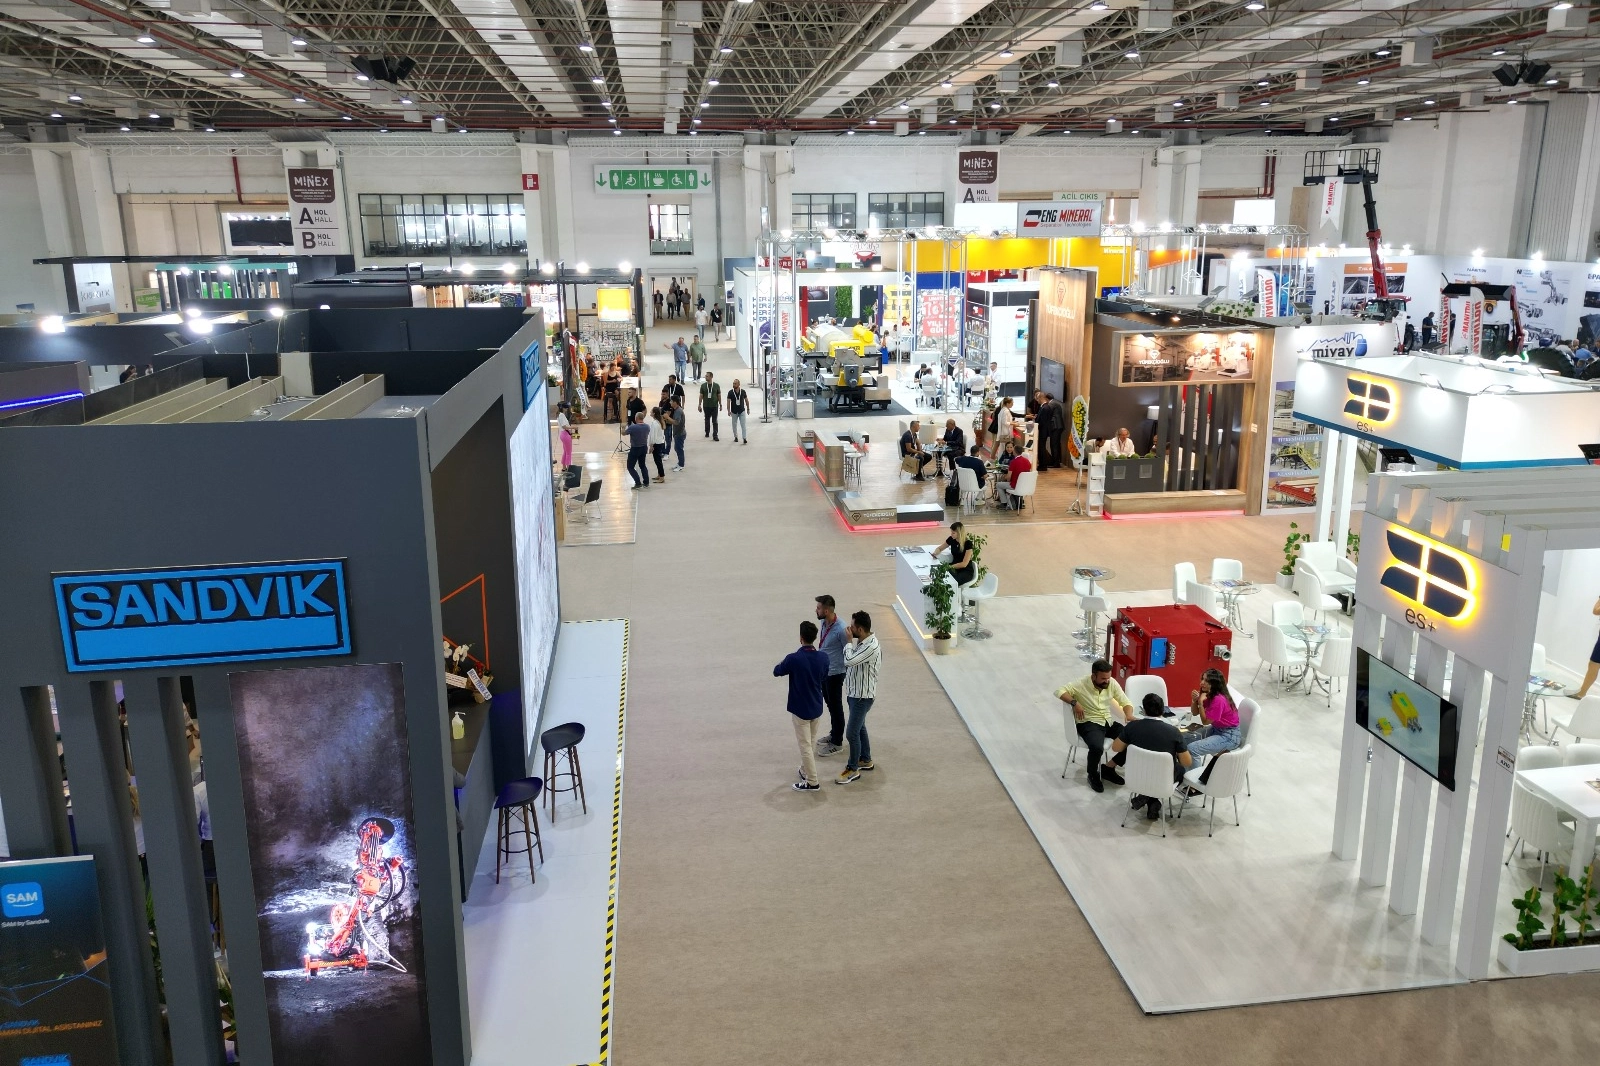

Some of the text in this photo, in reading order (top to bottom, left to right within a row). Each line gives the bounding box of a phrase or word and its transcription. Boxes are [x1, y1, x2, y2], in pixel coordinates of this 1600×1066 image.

[963, 157, 993, 169] MINEX
[293, 175, 329, 187] MINEX
[963, 188, 975, 203] A
[299, 207, 315, 225] A
[1059, 208, 1093, 222] MINERAL
[1064, 221, 1092, 229] Technologies
[301, 231, 316, 249] B
[1312, 345, 1354, 358] miyay
[1356, 420, 1374, 434] es+
[70, 573, 335, 628] SANDVIK
[1405, 608, 1436, 632] es+
[6, 891, 38, 904] SAM
[1, 918, 50, 929] SAM by Sandvik
